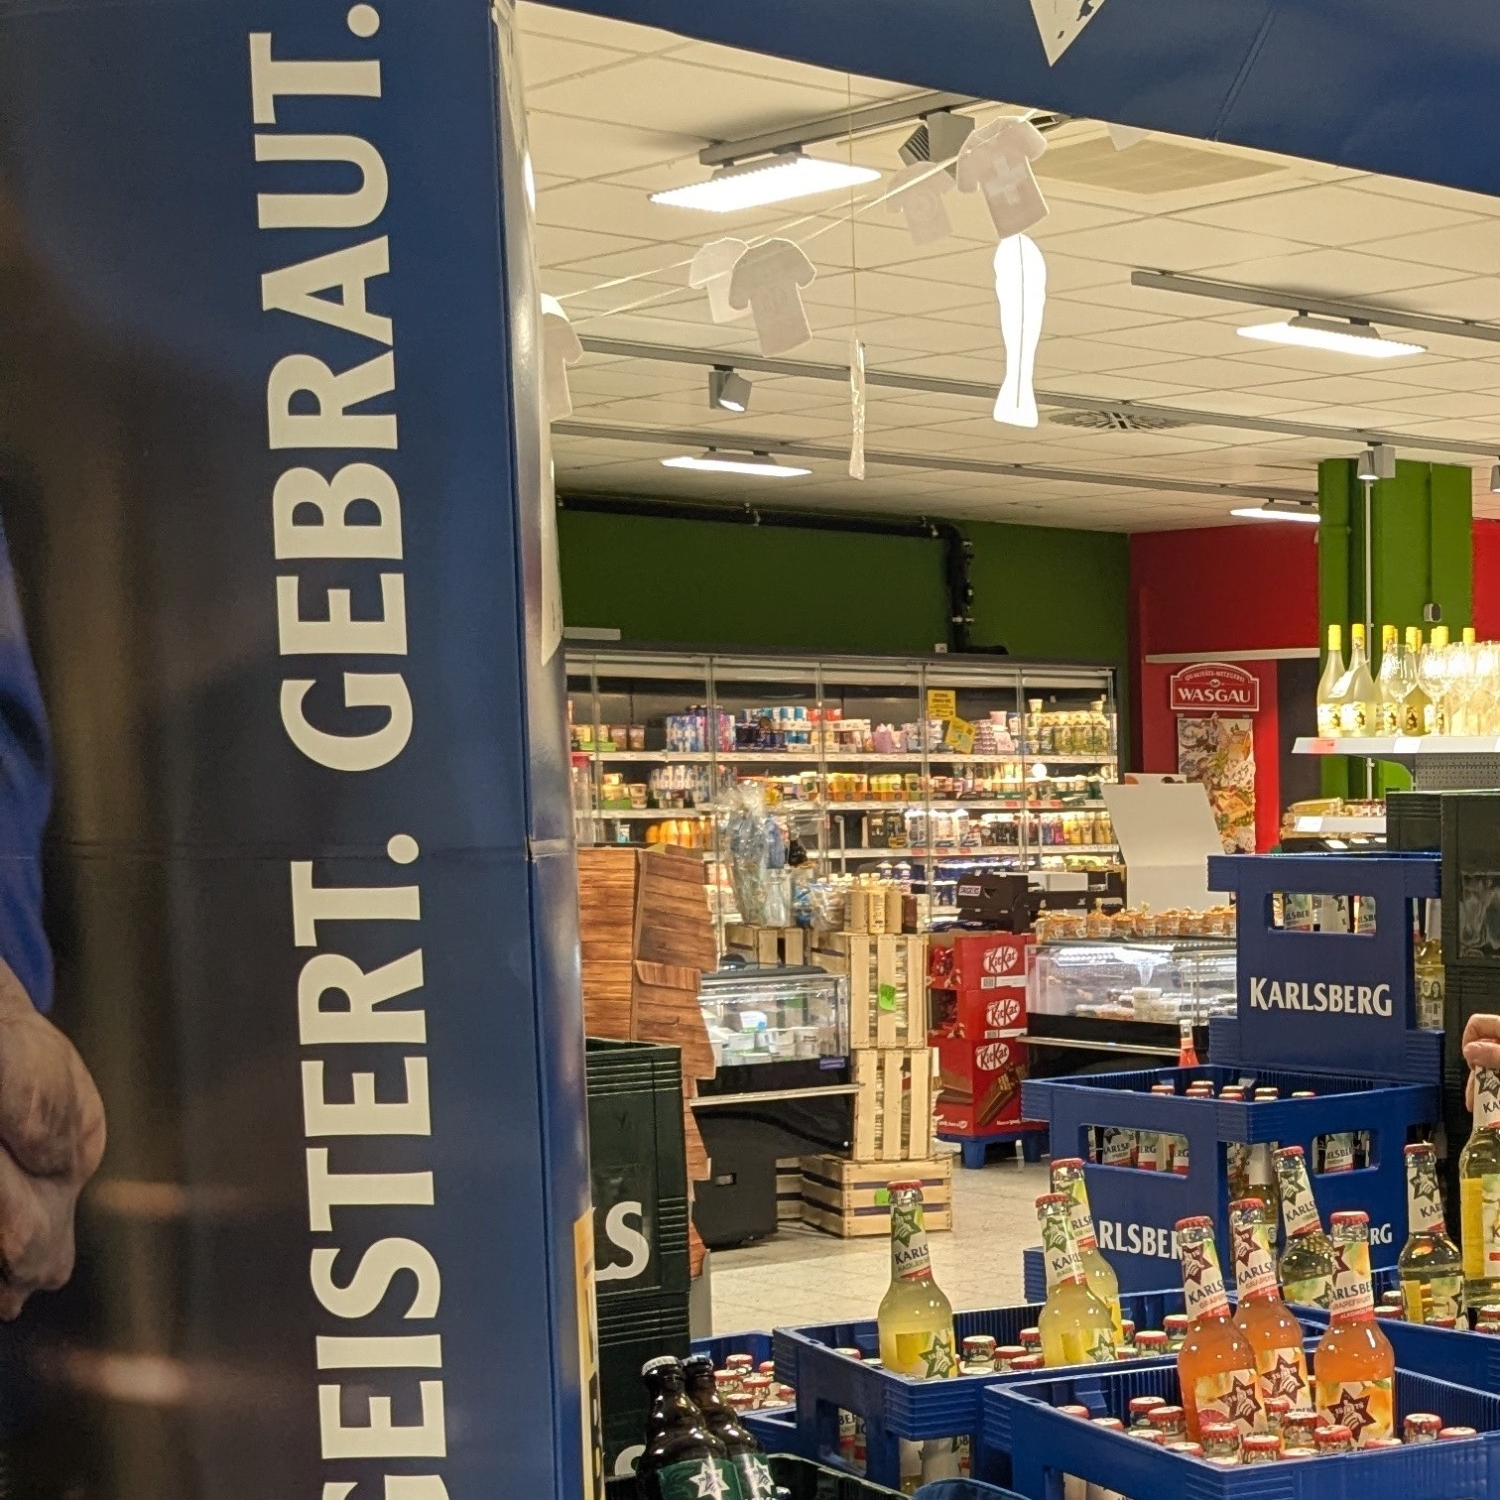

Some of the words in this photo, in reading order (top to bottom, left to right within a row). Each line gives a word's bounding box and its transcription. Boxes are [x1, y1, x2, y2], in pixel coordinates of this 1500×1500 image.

[249, 3, 414, 772] GEBRAUT.
[1178, 688, 1251, 703] WASGAU
[1250, 976, 1393, 1017] KARLSBERG
[1285, 1200, 1315, 1222] KARLS
[893, 1243, 929, 1265] KARLS
[1238, 1261, 1271, 1286] KARLS
[1188, 1279, 1223, 1305] KARLS
